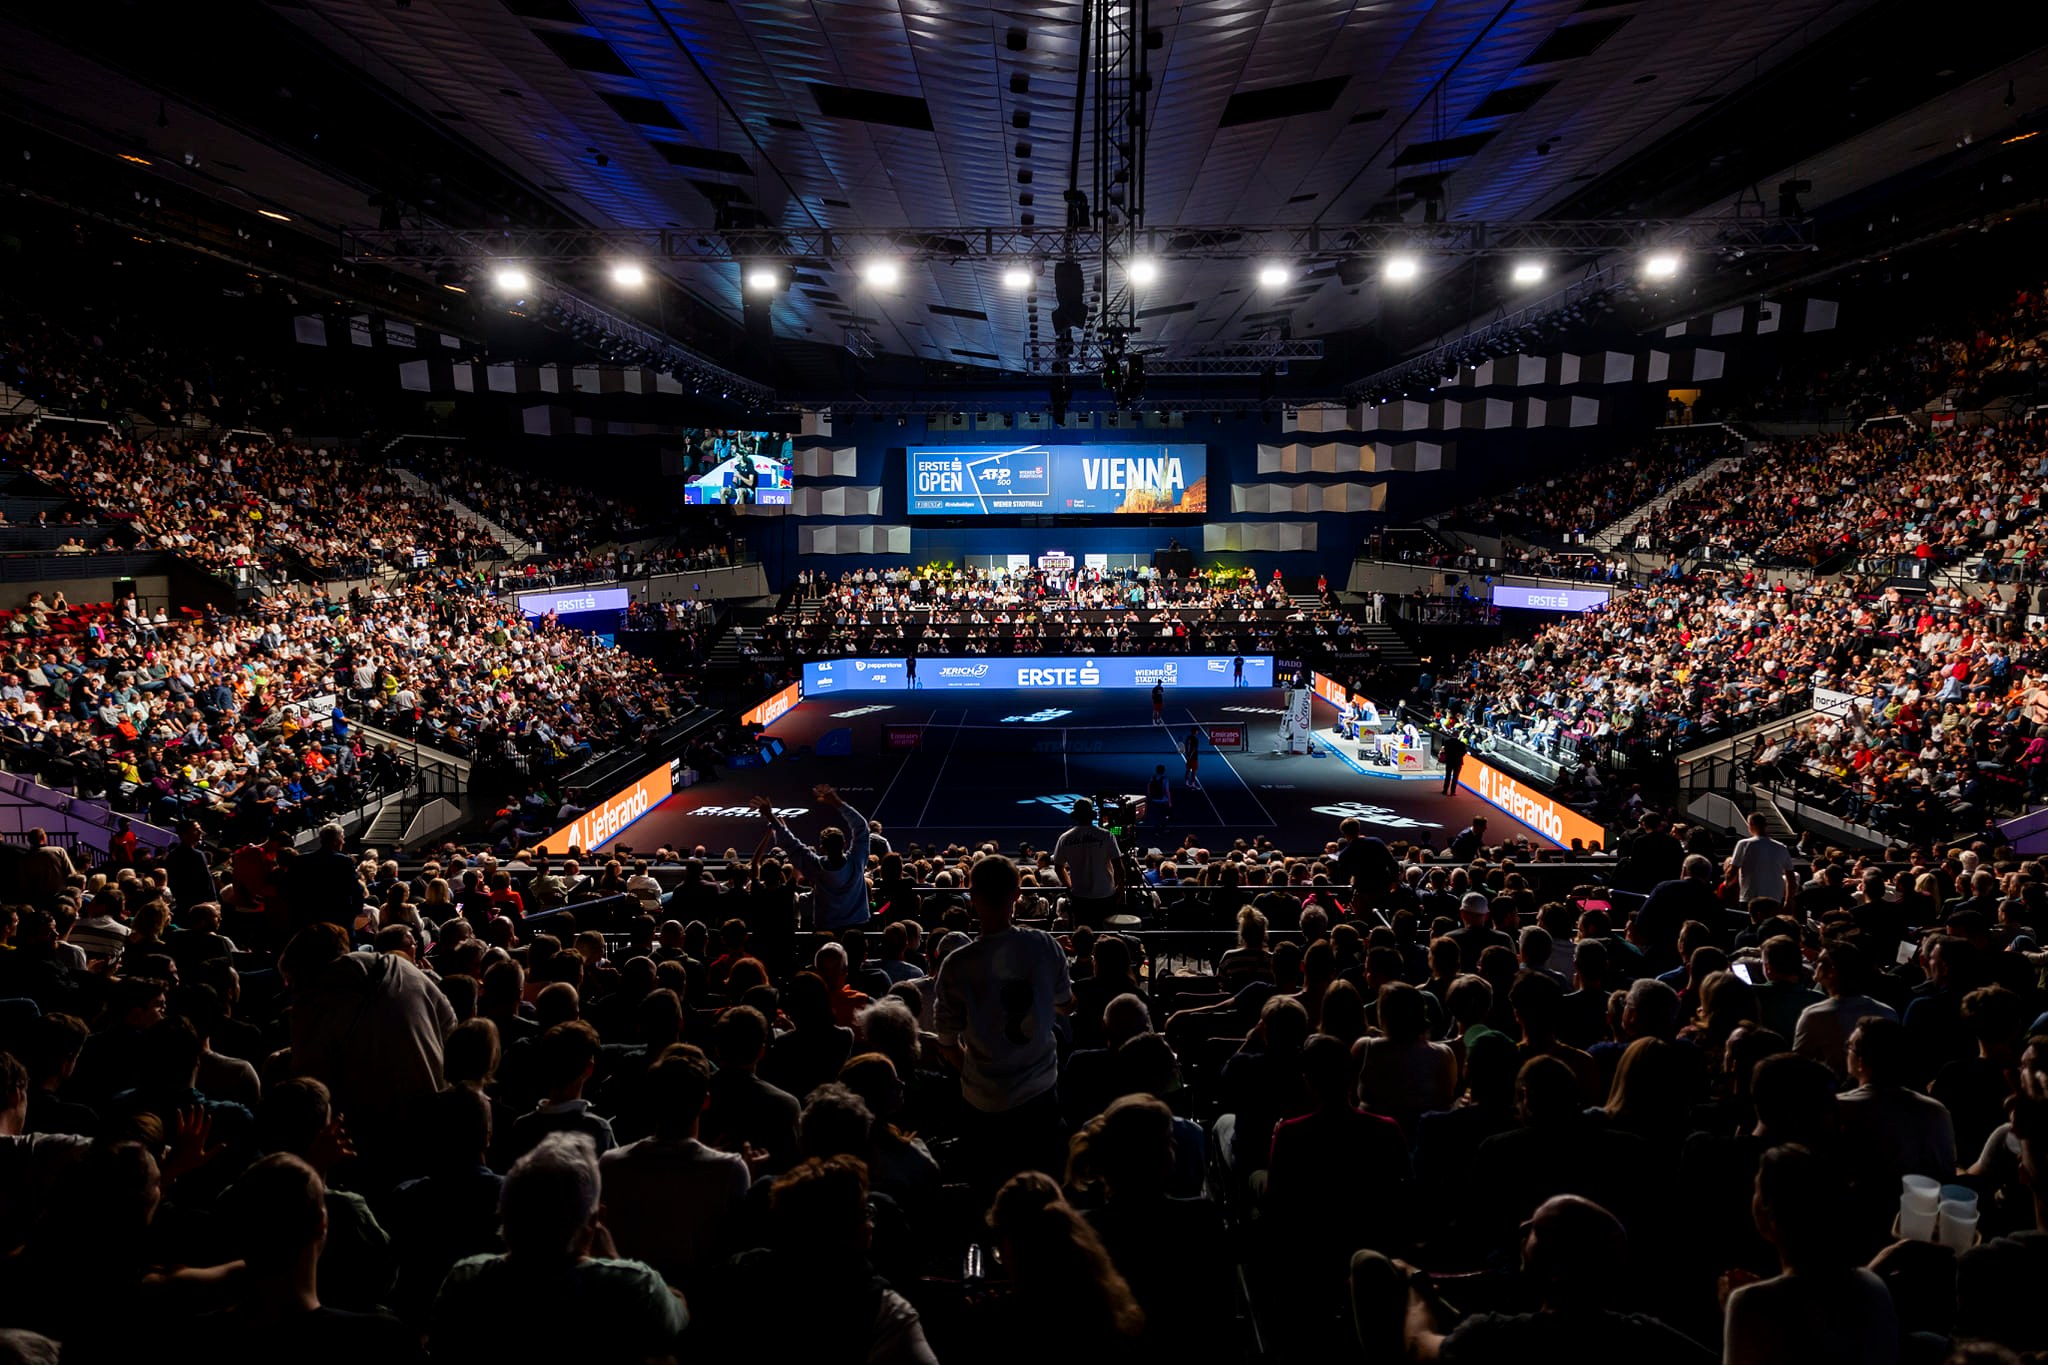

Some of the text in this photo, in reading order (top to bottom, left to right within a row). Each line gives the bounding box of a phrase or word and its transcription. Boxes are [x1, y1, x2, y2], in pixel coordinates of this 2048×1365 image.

[919, 461, 950, 471] ERSTE
[978, 468, 1011, 480] ATP
[1082, 457, 1185, 490] VIENNA
[919, 472, 963, 492] OPEN
[763, 495, 785, 504] LET'S GO
[993, 500, 1043, 508] WIENER STADTHALLE
[557, 598, 586, 612] ERSTE
[1527, 594, 1557, 607] ERSTE
[939, 667, 976, 675] JERICH
[1018, 668, 1077, 686] ERSTE
[1210, 731, 1240, 739] Emirates
[1491, 770, 1563, 841] Lieferando
[584, 783, 649, 850] Lieferando
